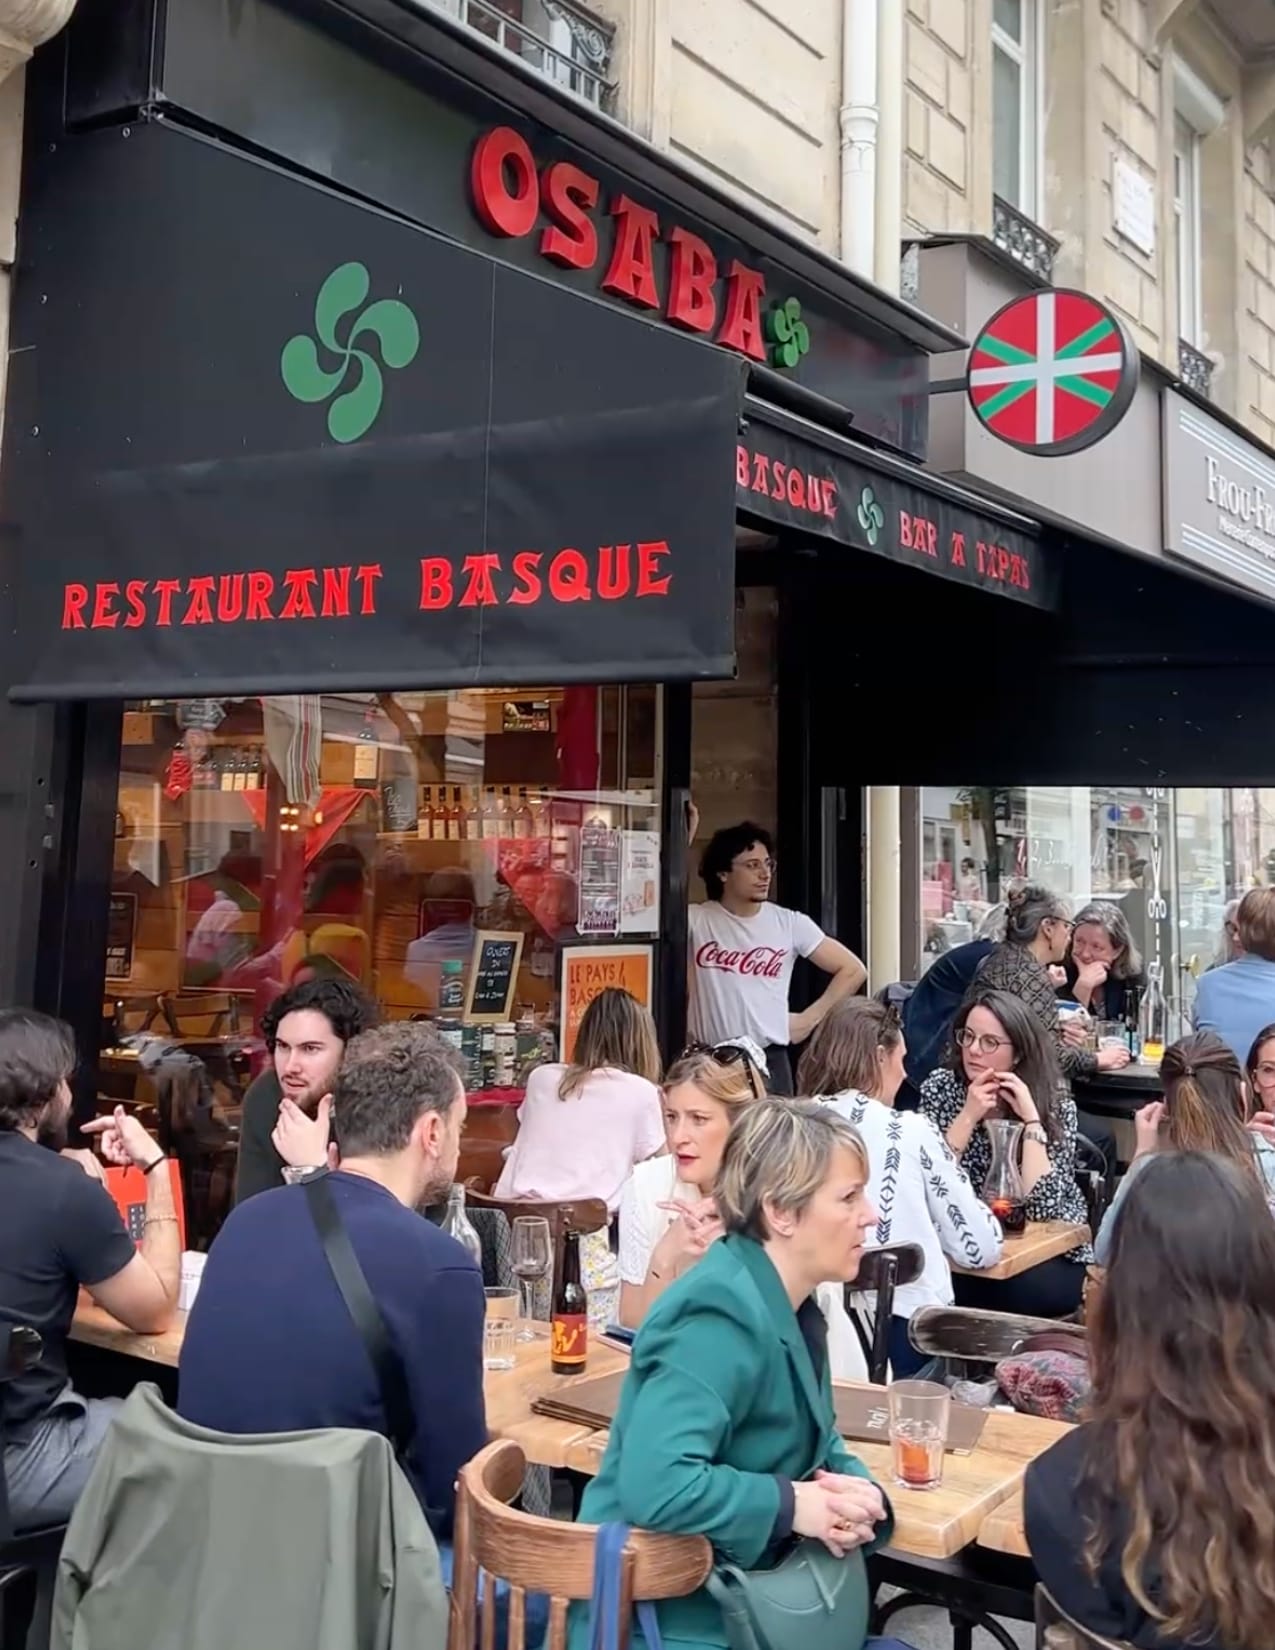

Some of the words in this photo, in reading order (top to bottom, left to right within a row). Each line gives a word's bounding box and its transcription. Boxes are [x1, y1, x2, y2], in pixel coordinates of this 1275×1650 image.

[472, 125, 767, 362] OSABA
[736, 445, 837, 519] BASQUE
[899, 510, 939, 558] BAR
[951, 532, 967, 567] A
[976, 541, 1031, 591] TAPAS
[61, 562, 383, 630] RESTAURANT
[419, 541, 673, 610] BASQUE
[570, 965, 580, 983] LE
[586, 964, 616, 982] PAYS
[696, 941, 788, 977] Coca-Cola
[570, 986, 602, 1006] BAS
